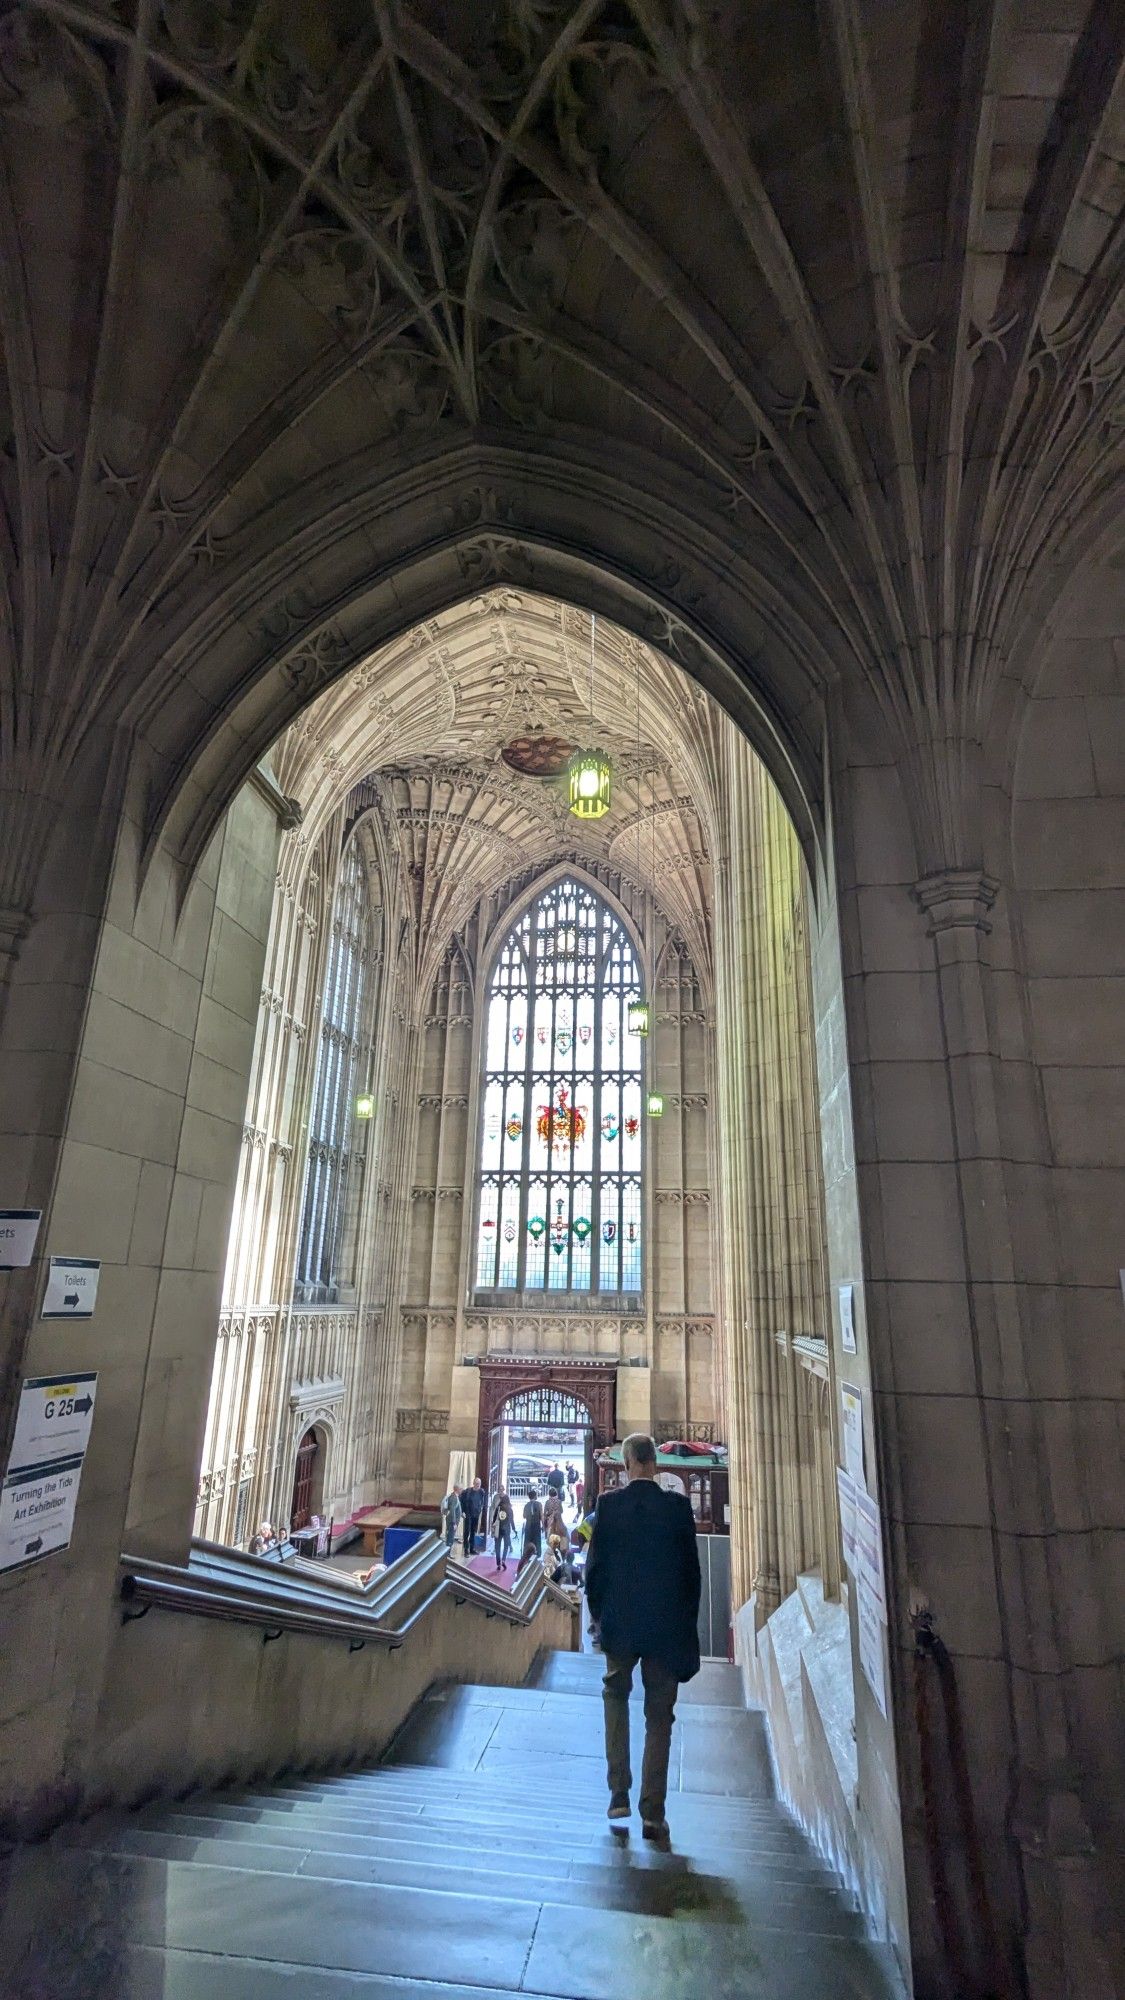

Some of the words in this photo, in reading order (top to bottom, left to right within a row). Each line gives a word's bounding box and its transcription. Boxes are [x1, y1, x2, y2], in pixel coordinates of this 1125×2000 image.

[64, 1274, 86, 1286] Toilets
[45, 1401, 54, 1419] G
[58, 1398, 74, 1418] 25
[11, 1486, 42, 1503] Turning
[44, 1482, 57, 1494] the
[59, 1477, 73, 1490] Tide
[14, 1508, 27, 1521] Art
[28, 1496, 66, 1516] Exhibition
